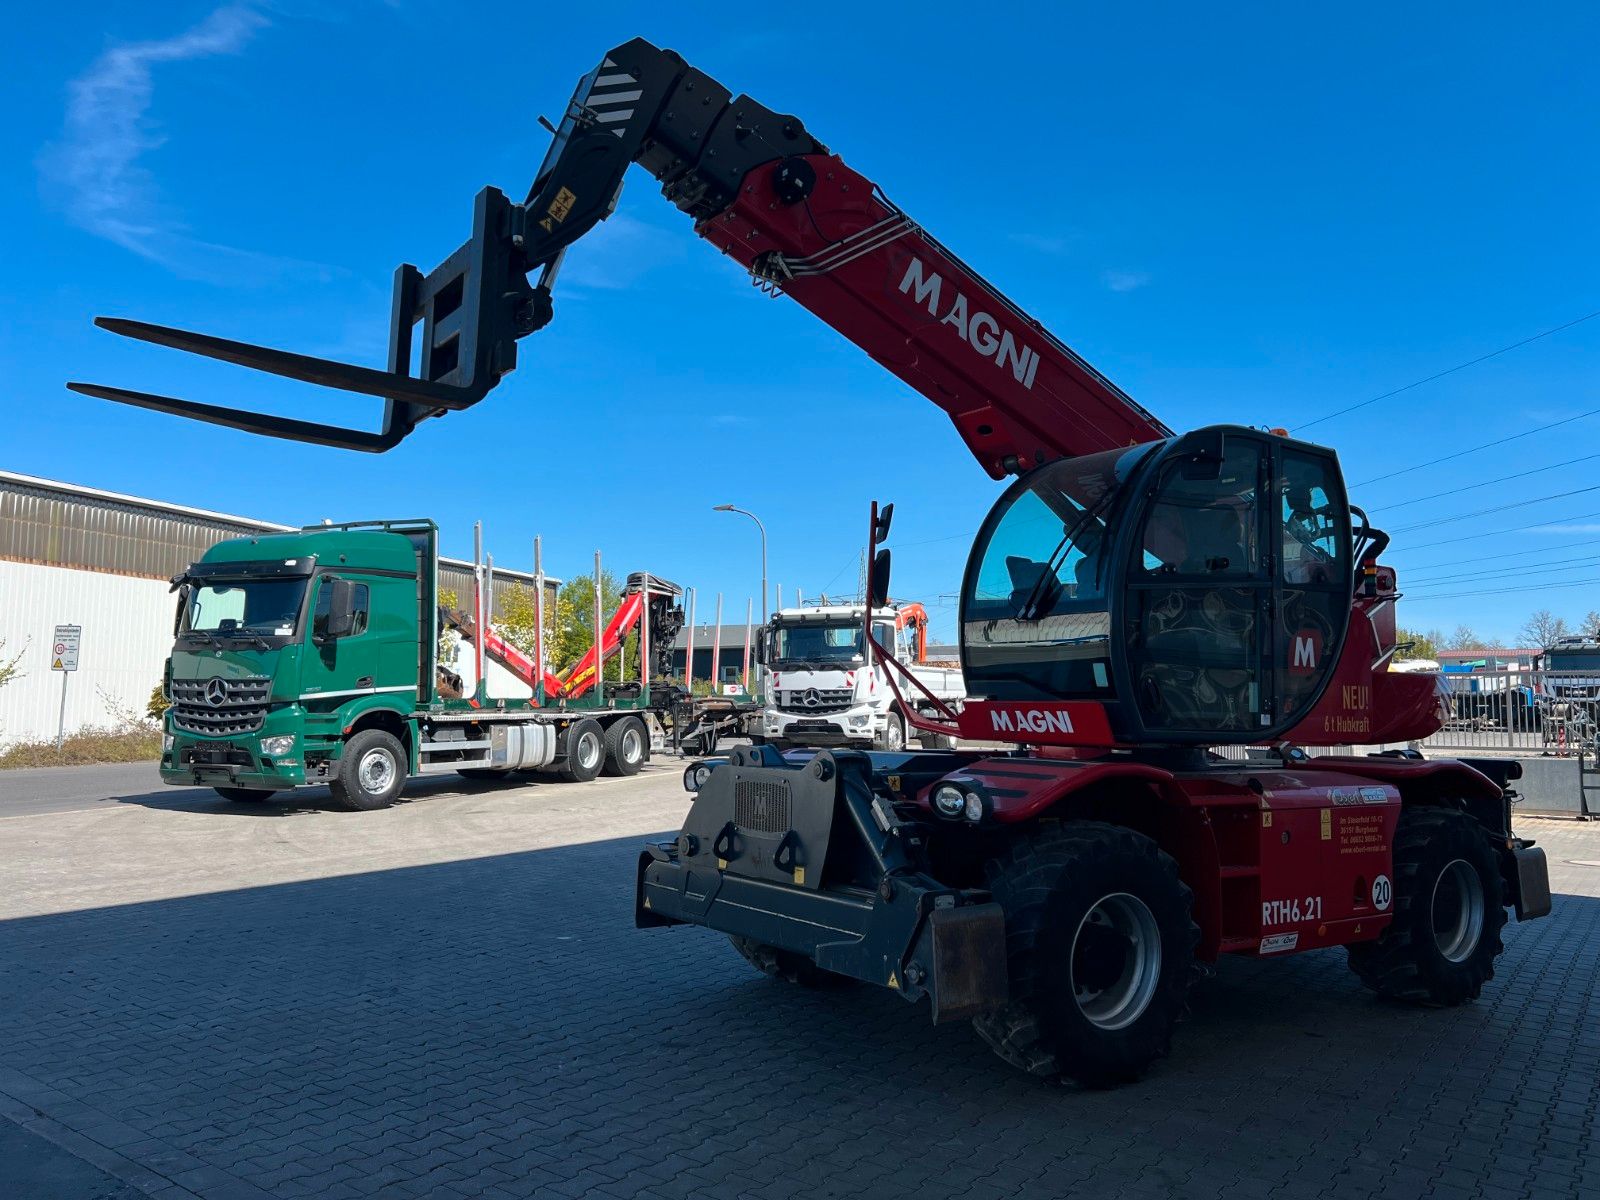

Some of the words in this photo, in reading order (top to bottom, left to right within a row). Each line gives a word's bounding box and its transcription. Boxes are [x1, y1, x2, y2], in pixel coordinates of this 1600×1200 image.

[898, 256, 1041, 390] MAGNI
[1294, 636, 1316, 667] M
[1342, 685, 1369, 710] NEU!
[990, 710, 1075, 733] MAGNI
[1324, 715, 1330, 732] 6
[1331, 716, 1335, 732] t
[1336, 715, 1370, 732] Hubkraft
[1374, 880, 1390, 904] 20
[1262, 896, 1322, 926] RTH6.21
